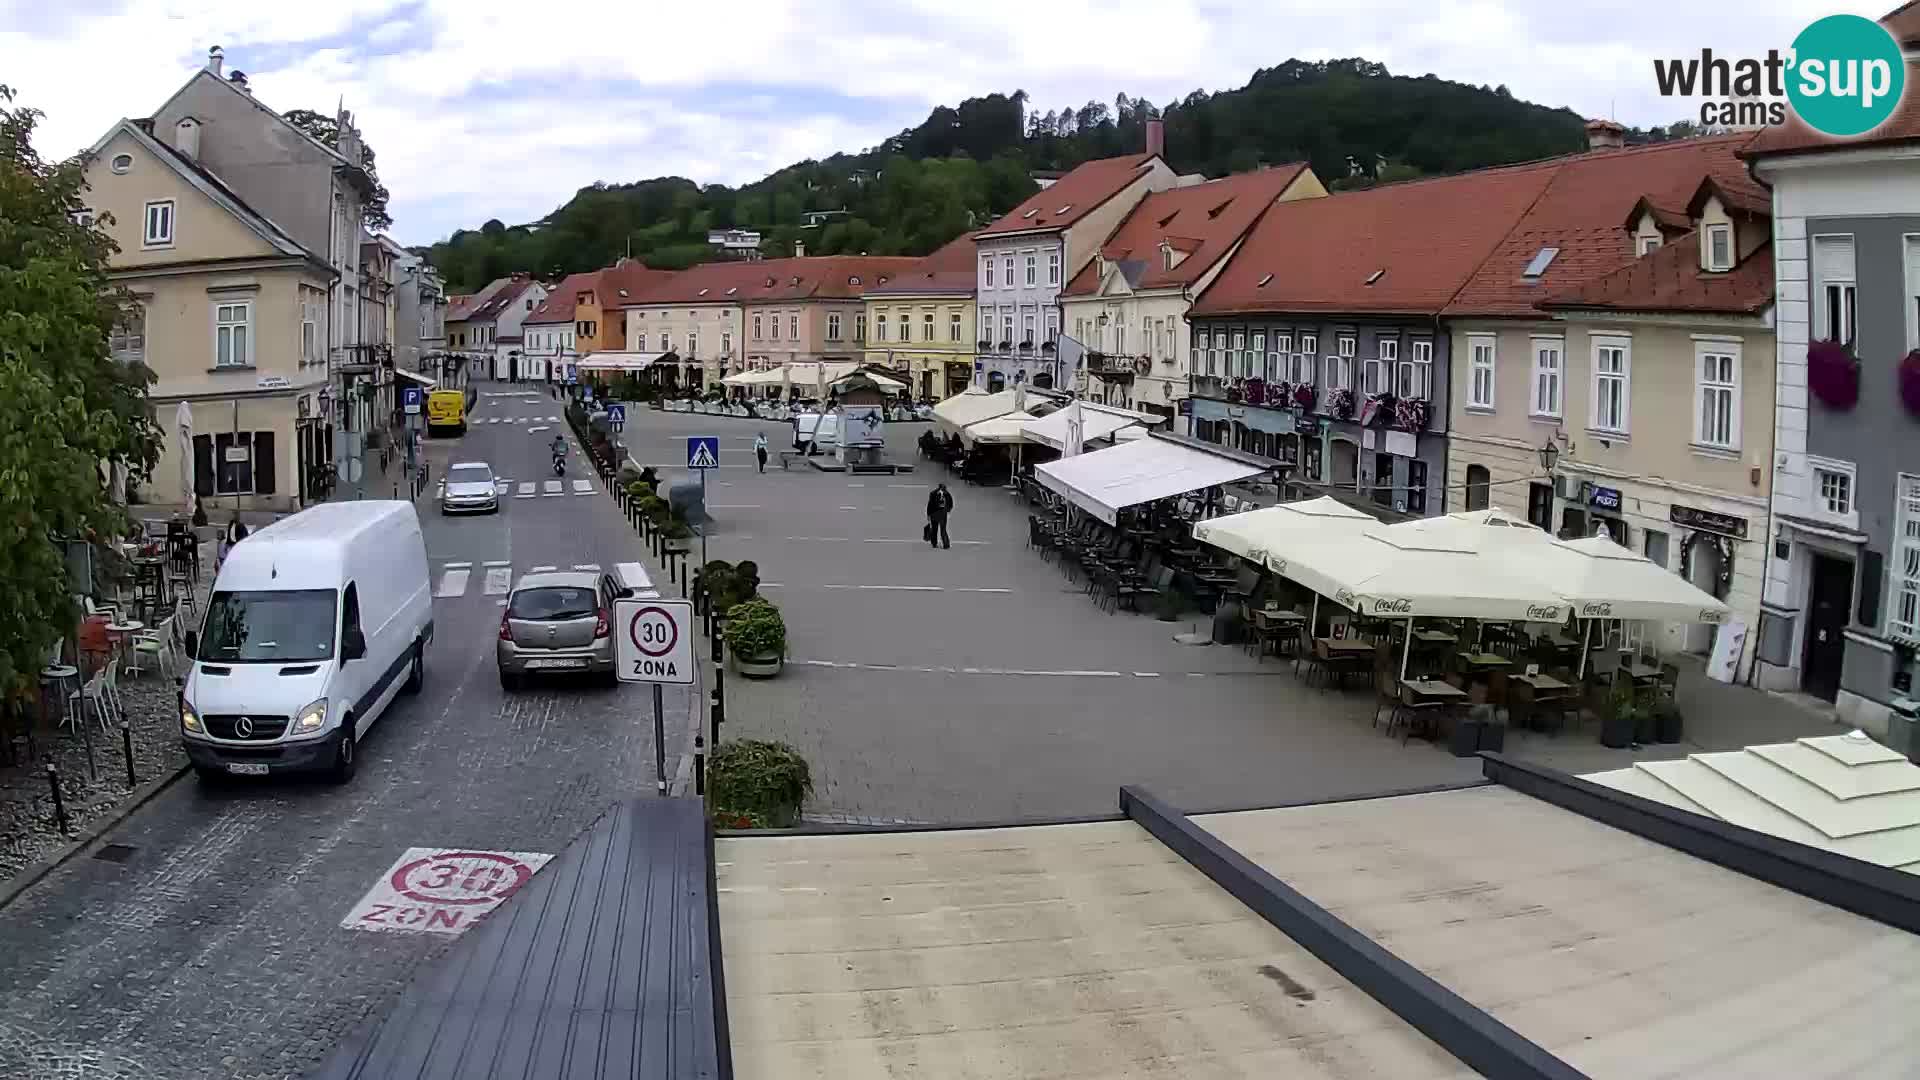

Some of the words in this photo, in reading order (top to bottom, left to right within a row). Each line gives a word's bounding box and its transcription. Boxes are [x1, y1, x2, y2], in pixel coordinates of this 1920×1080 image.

[643, 622, 666, 643] 30
[633, 660, 677, 676] ZONA
[419, 864, 504, 892] 30
